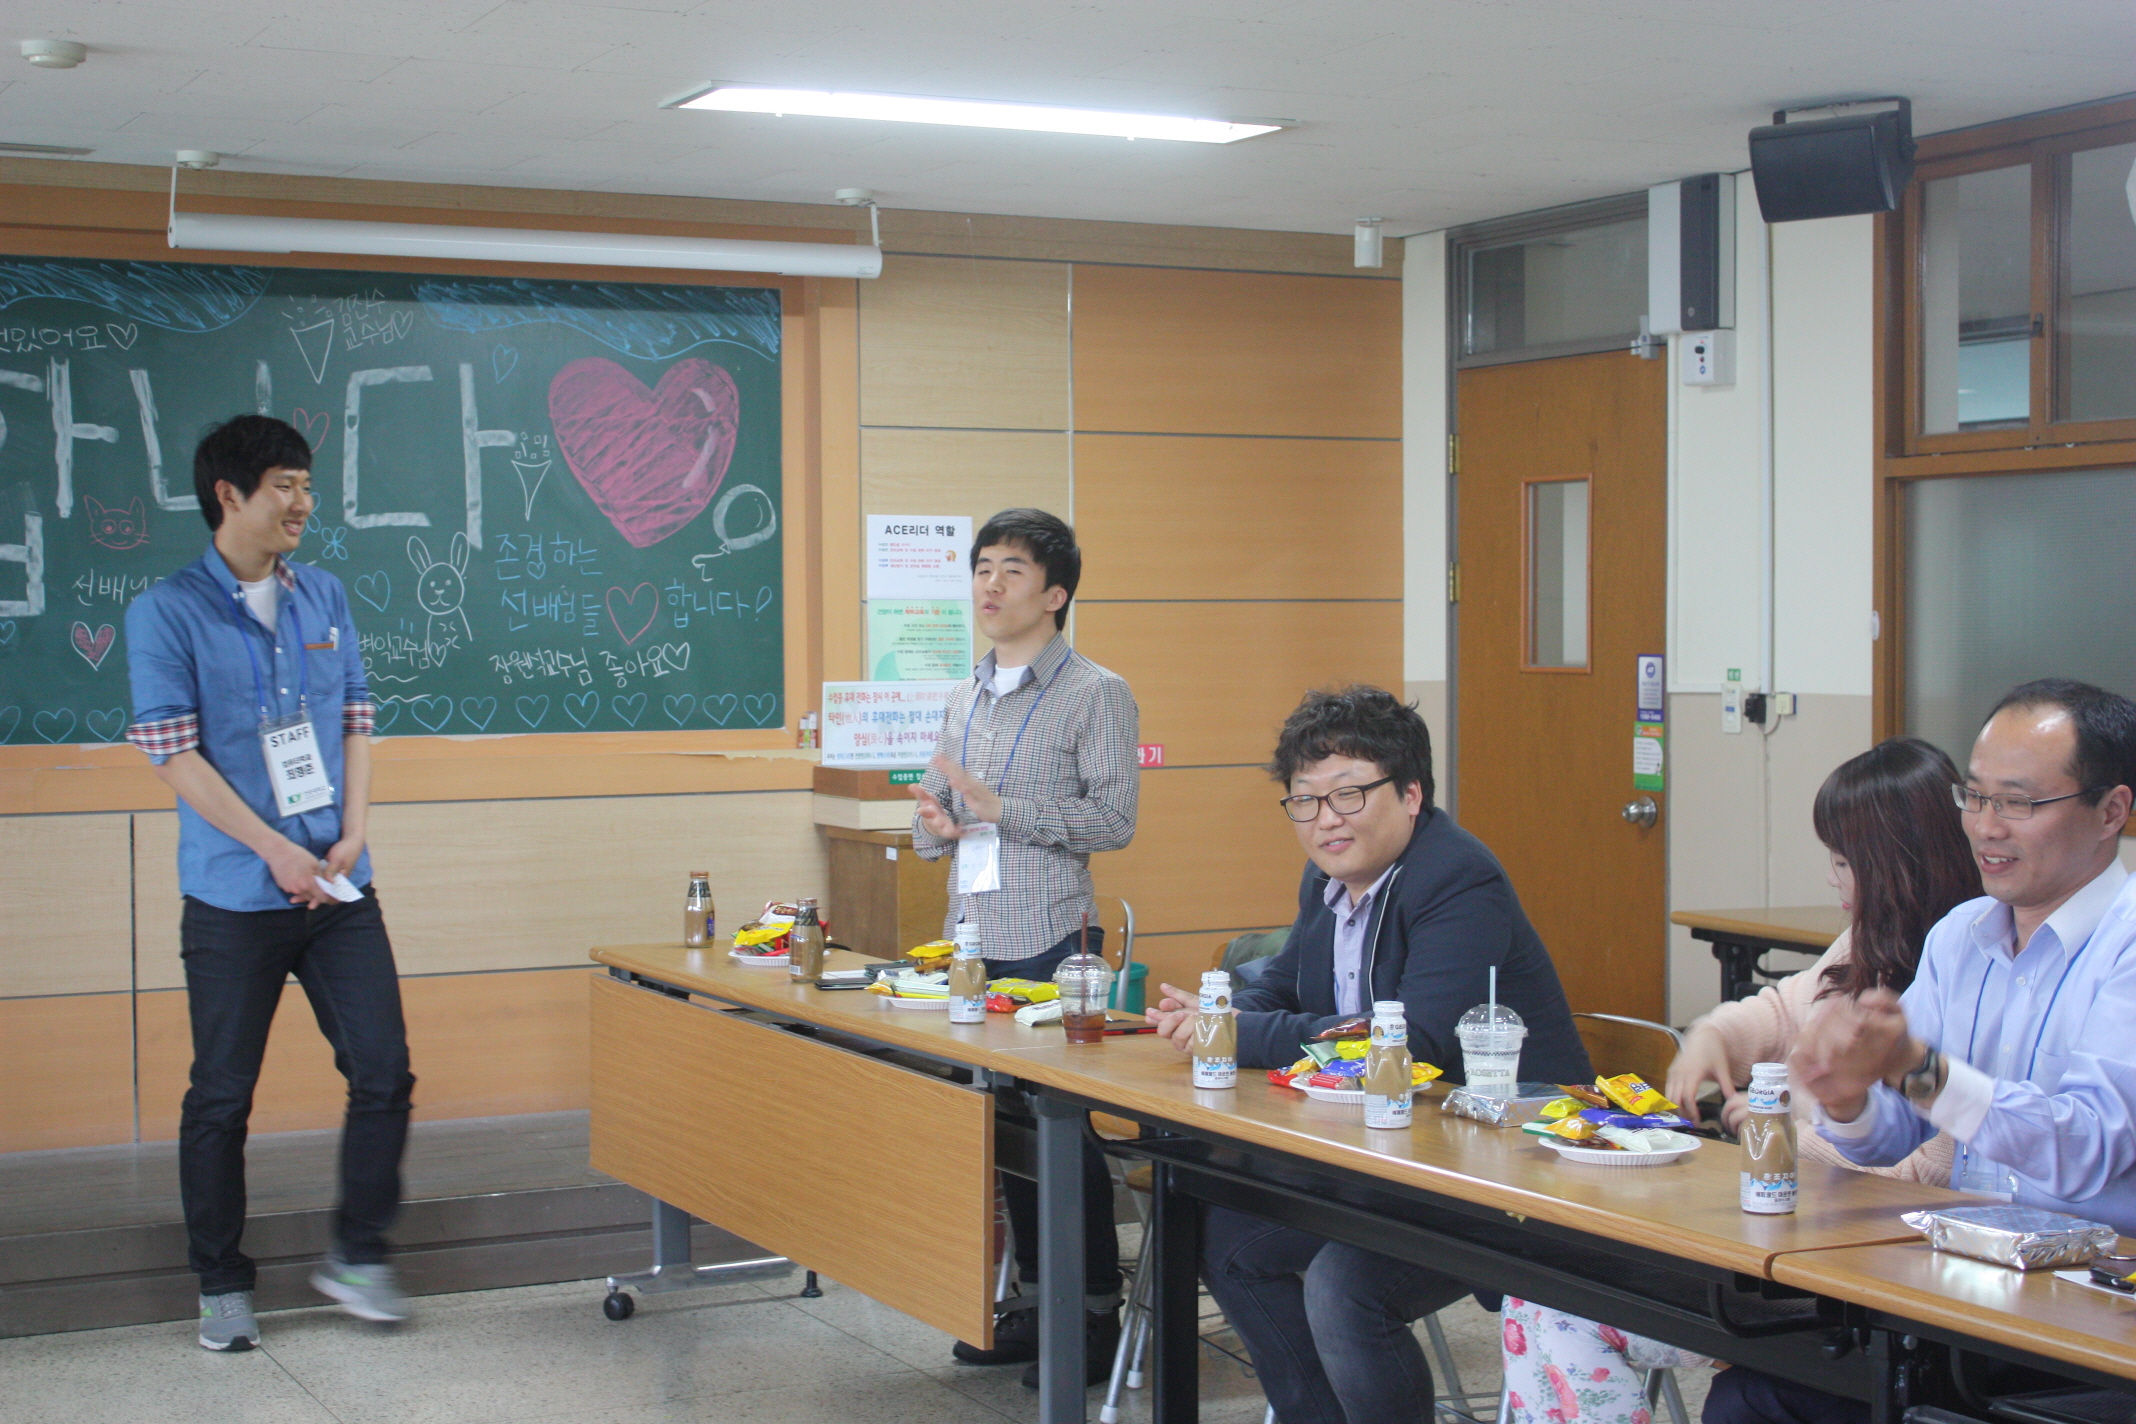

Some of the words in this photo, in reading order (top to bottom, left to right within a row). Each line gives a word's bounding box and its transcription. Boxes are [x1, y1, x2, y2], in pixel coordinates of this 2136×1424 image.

[884, 525, 930, 536] ACE리더
[935, 525, 956, 537] 역할
[495, 531, 603, 580] 존경하는
[501, 588, 601, 636] 선배님들
[599, 645, 670, 688] 좋아요
[871, 711, 905, 725] 휴대전화는
[909, 710, 922, 724] 절대
[270, 726, 310, 748] STAFF
[897, 731, 917, 745] 속이지
[1470, 1068, 1511, 1078] ROSETTA
[1749, 1086, 1775, 1096] GEORGIA
